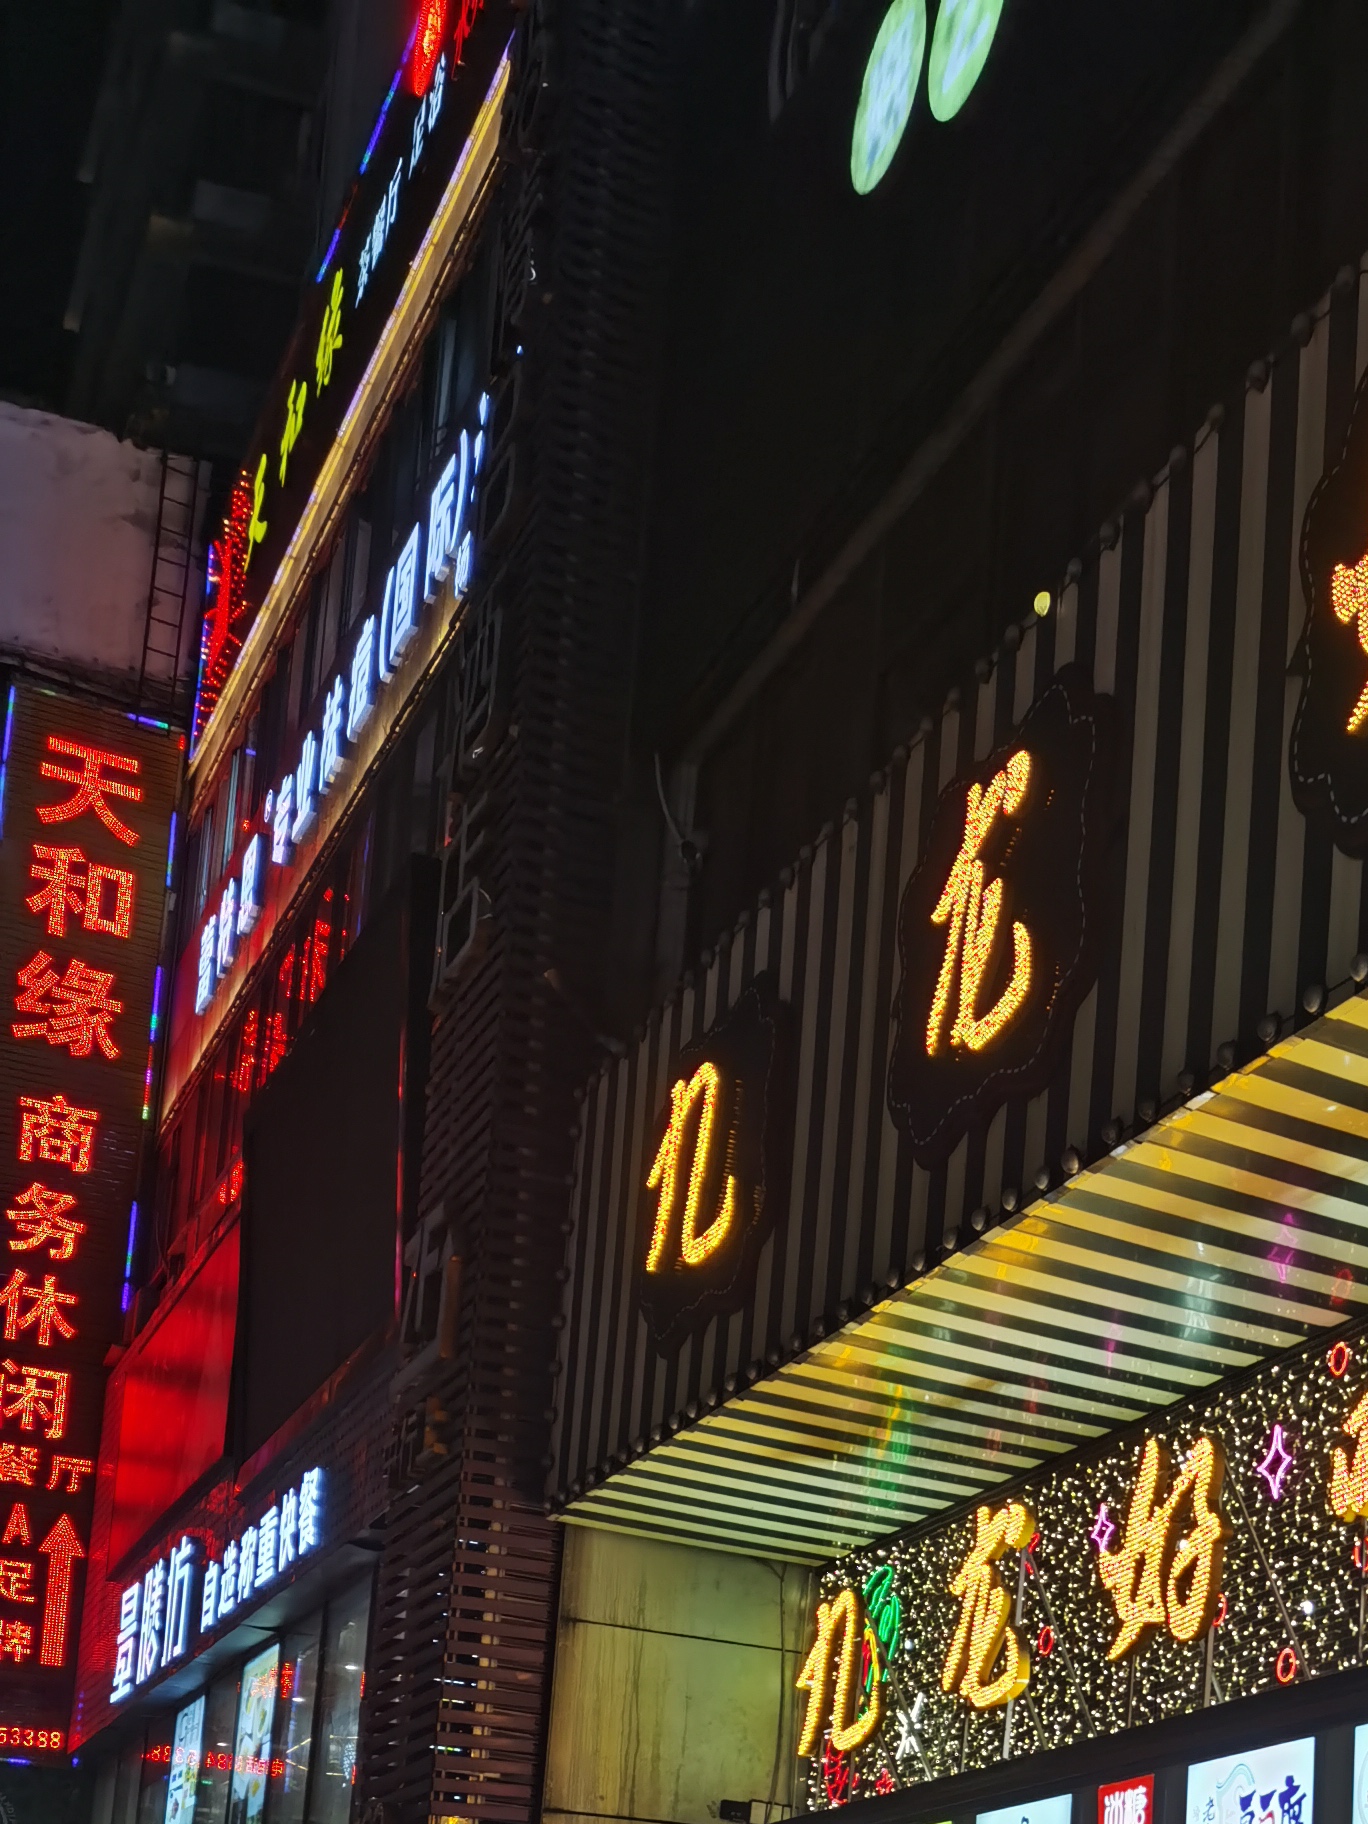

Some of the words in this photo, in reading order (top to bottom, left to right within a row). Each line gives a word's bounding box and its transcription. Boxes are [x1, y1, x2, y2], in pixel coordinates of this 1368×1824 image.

[11, 736, 142, 1060] 天和缘
[0, 1093, 100, 1440] 商务休闲
[200, 1467, 324, 1634] 自选称重快餐
